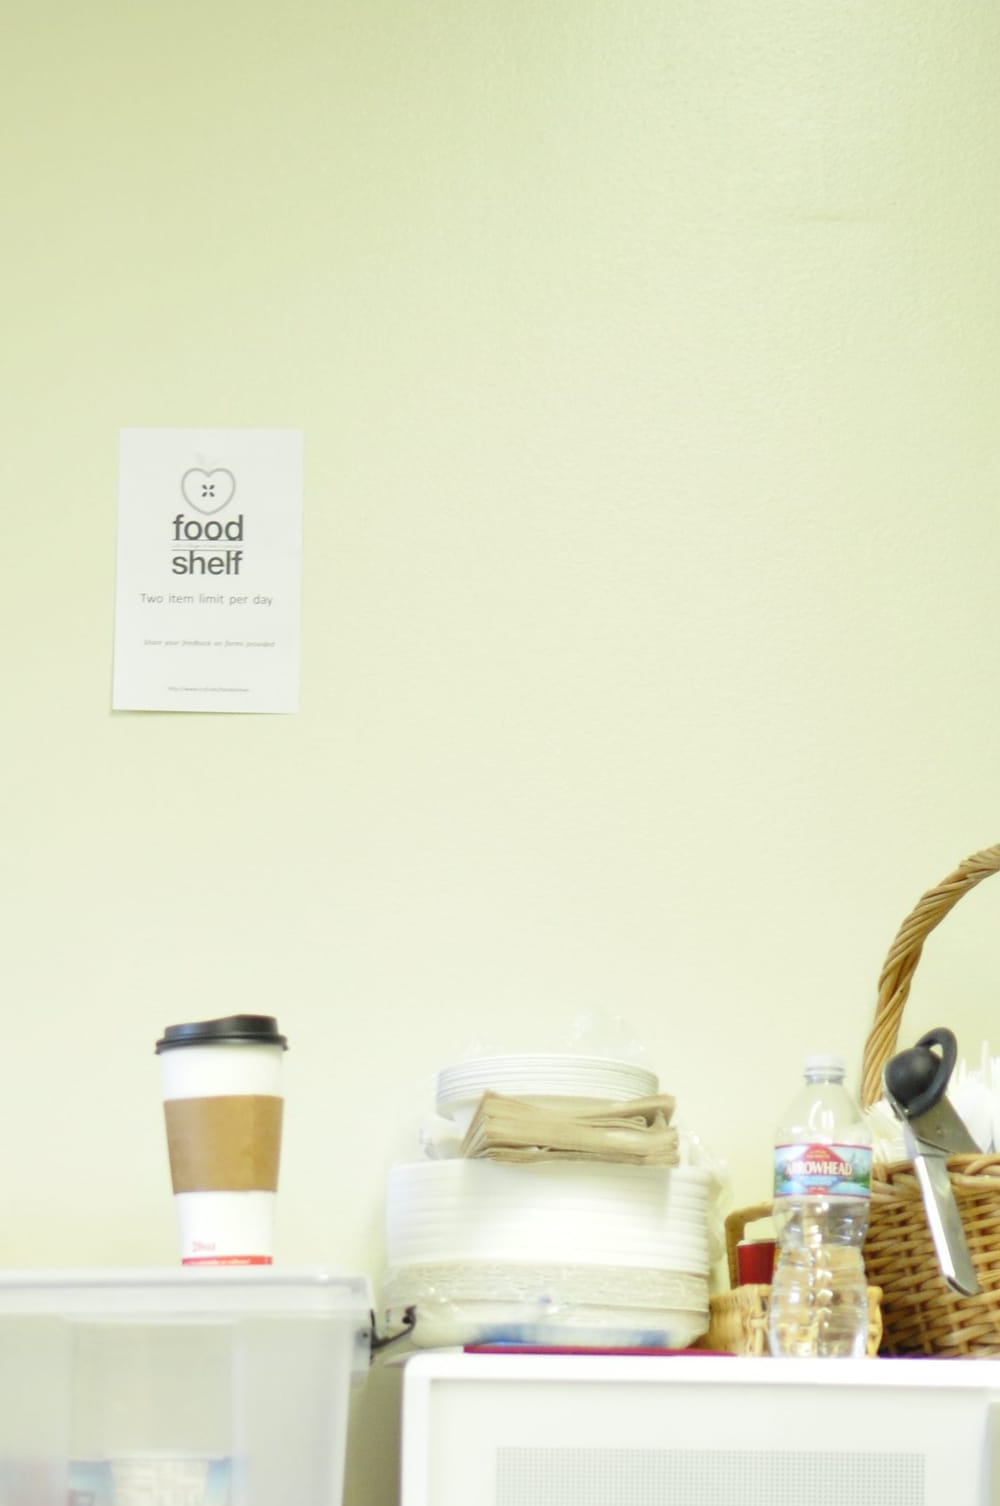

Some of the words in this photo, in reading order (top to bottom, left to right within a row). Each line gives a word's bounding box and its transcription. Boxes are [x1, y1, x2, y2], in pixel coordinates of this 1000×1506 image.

[172, 514, 243, 541] food
[172, 550, 243, 575] shelf
[140, 593, 164, 604] Two
[168, 594, 194, 604] item
[199, 594, 224, 605] limit
[229, 596, 248, 606] per
[252, 595, 273, 607] day
